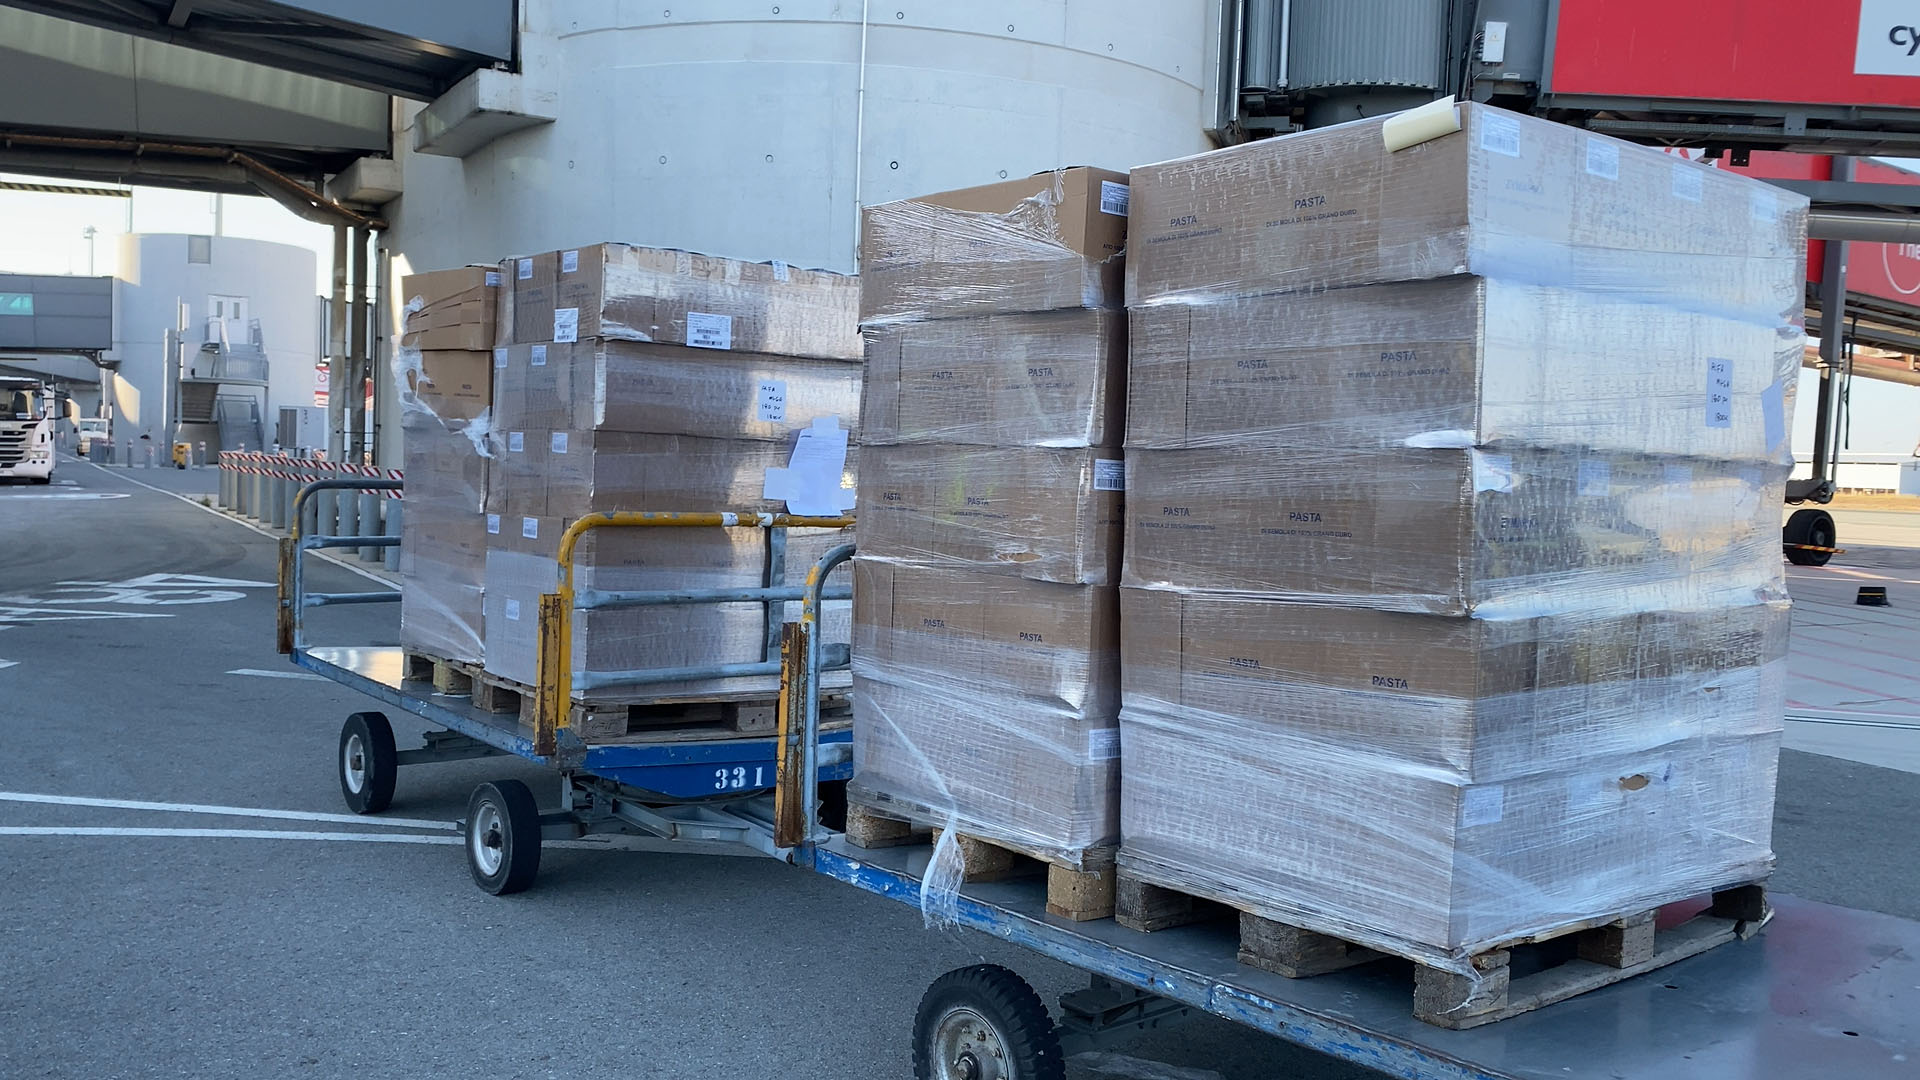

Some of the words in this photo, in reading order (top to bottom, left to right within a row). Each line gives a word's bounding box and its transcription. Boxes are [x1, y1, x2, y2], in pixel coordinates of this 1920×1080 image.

[1294, 195, 1327, 209] PASTA
[1170, 215, 1197, 227] PASTA
[1380, 350, 1417, 362] PASTA
[1237, 359, 1268, 370] PASTA
[1028, 367, 1053, 377] PASTA
[967, 497, 989, 506] PASTA
[1163, 507, 1190, 517] PASTA
[1289, 511, 1322, 523] PASTA
[923, 619, 945, 628] PASTA
[1020, 632, 1042, 642] PASTA
[1229, 657, 1261, 669] PASTA
[1371, 675, 1409, 690] PASTA
[715, 767, 763, 789] 331
